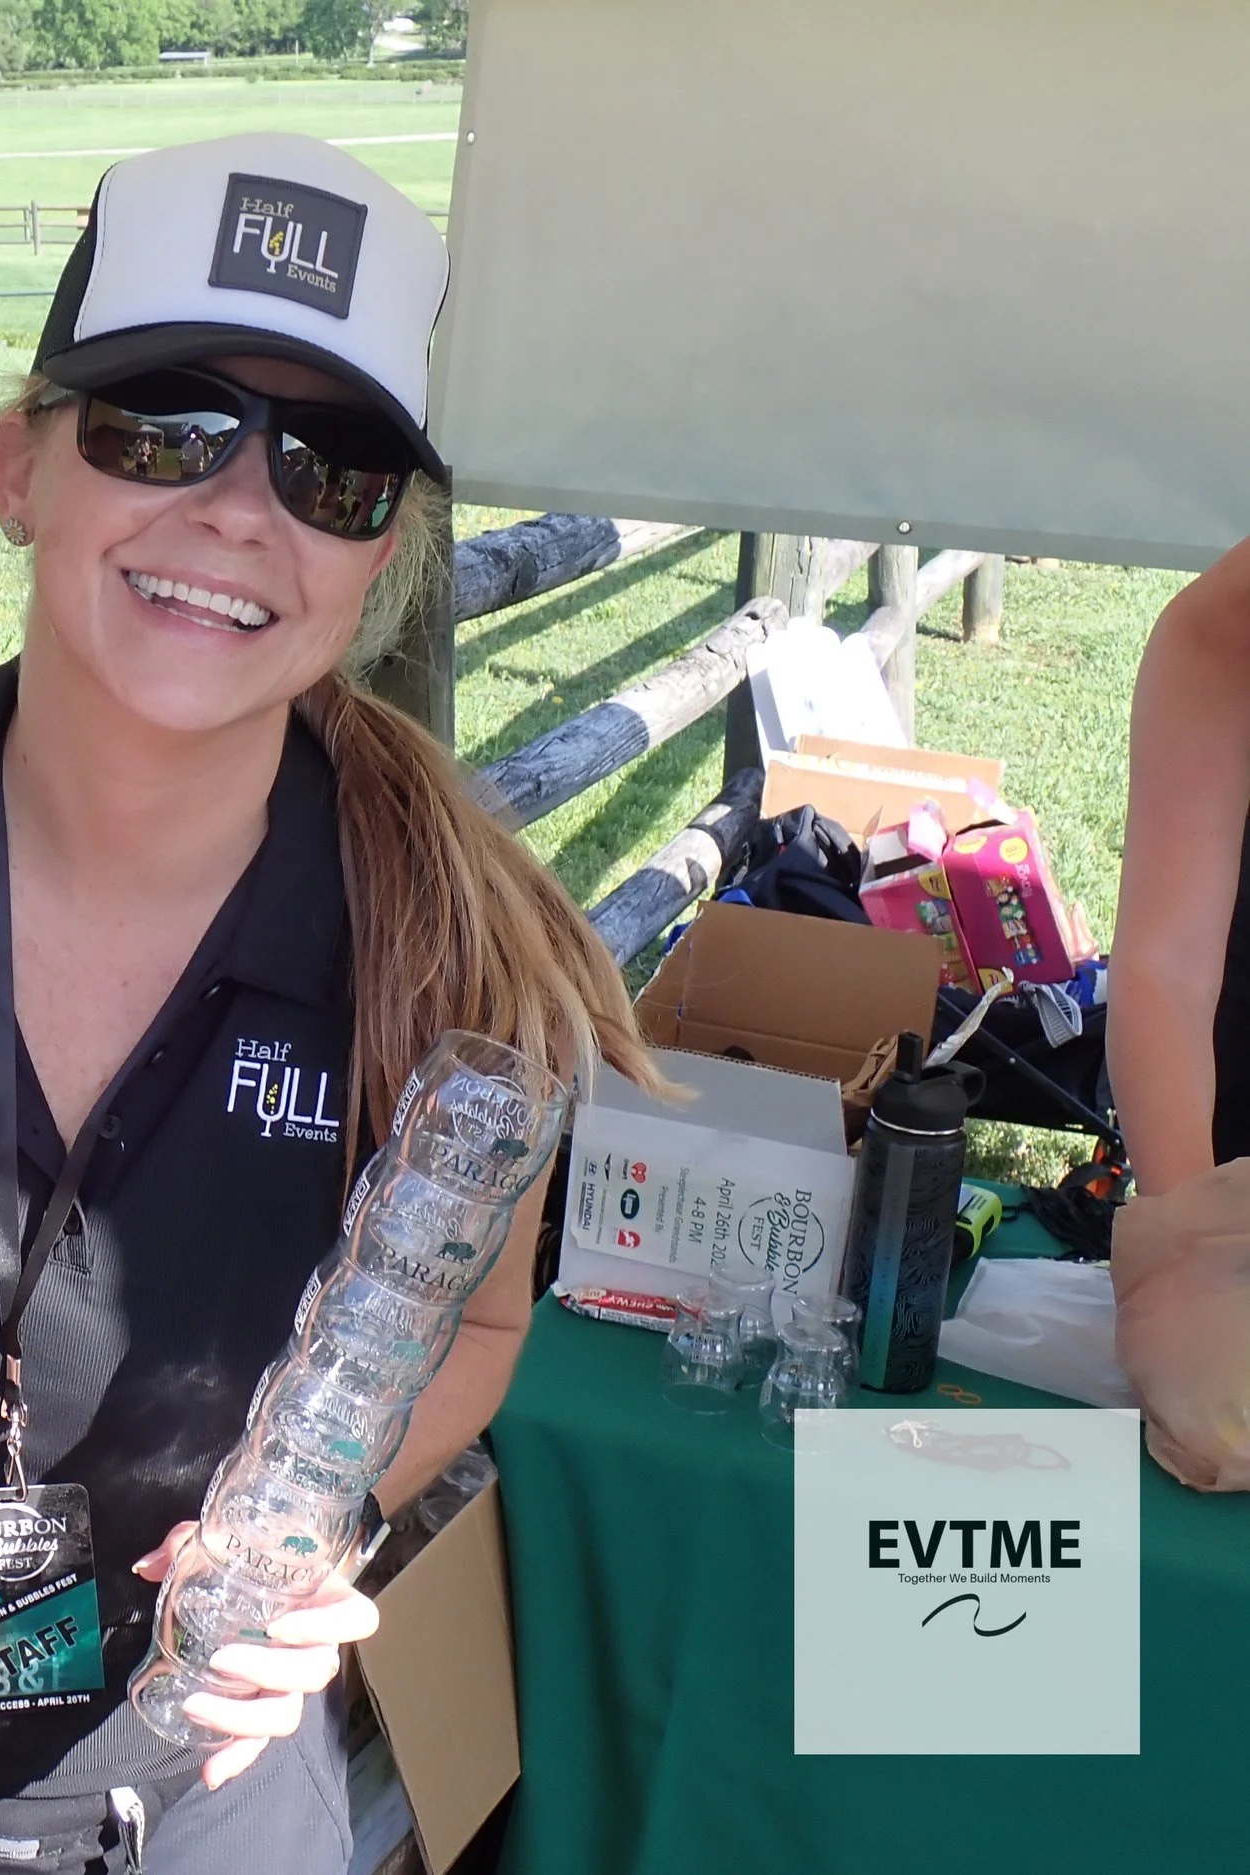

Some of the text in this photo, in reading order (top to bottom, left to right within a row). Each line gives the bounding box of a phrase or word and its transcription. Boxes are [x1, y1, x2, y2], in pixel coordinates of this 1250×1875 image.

[239, 196, 295, 219] Half
[232, 212, 339, 279] FULL
[286, 263, 338, 293] Events
[234, 1038, 292, 1062] Half
[227, 1059, 340, 1138] FULL
[282, 1121, 338, 1143] Events
[582, 1182, 596, 1231] HYUNDAI
[716, 1176, 736, 1210] April
[688, 1196, 707, 1245] 4-8 PM
[713, 1211, 732, 1241] 26th
[749, 1215, 765, 1252] FEST
[764, 1207, 791, 1272] Bubble
[782, 1188, 812, 1295] BOURBON
[608, 1294, 655, 1309] CHEWY
[7, 1602, 17, 1613] &
[15, 1584, 56, 1609] BUBBLES
[55, 1573, 79, 1590] FEST
[37, 1696, 65, 1708] APRIL
